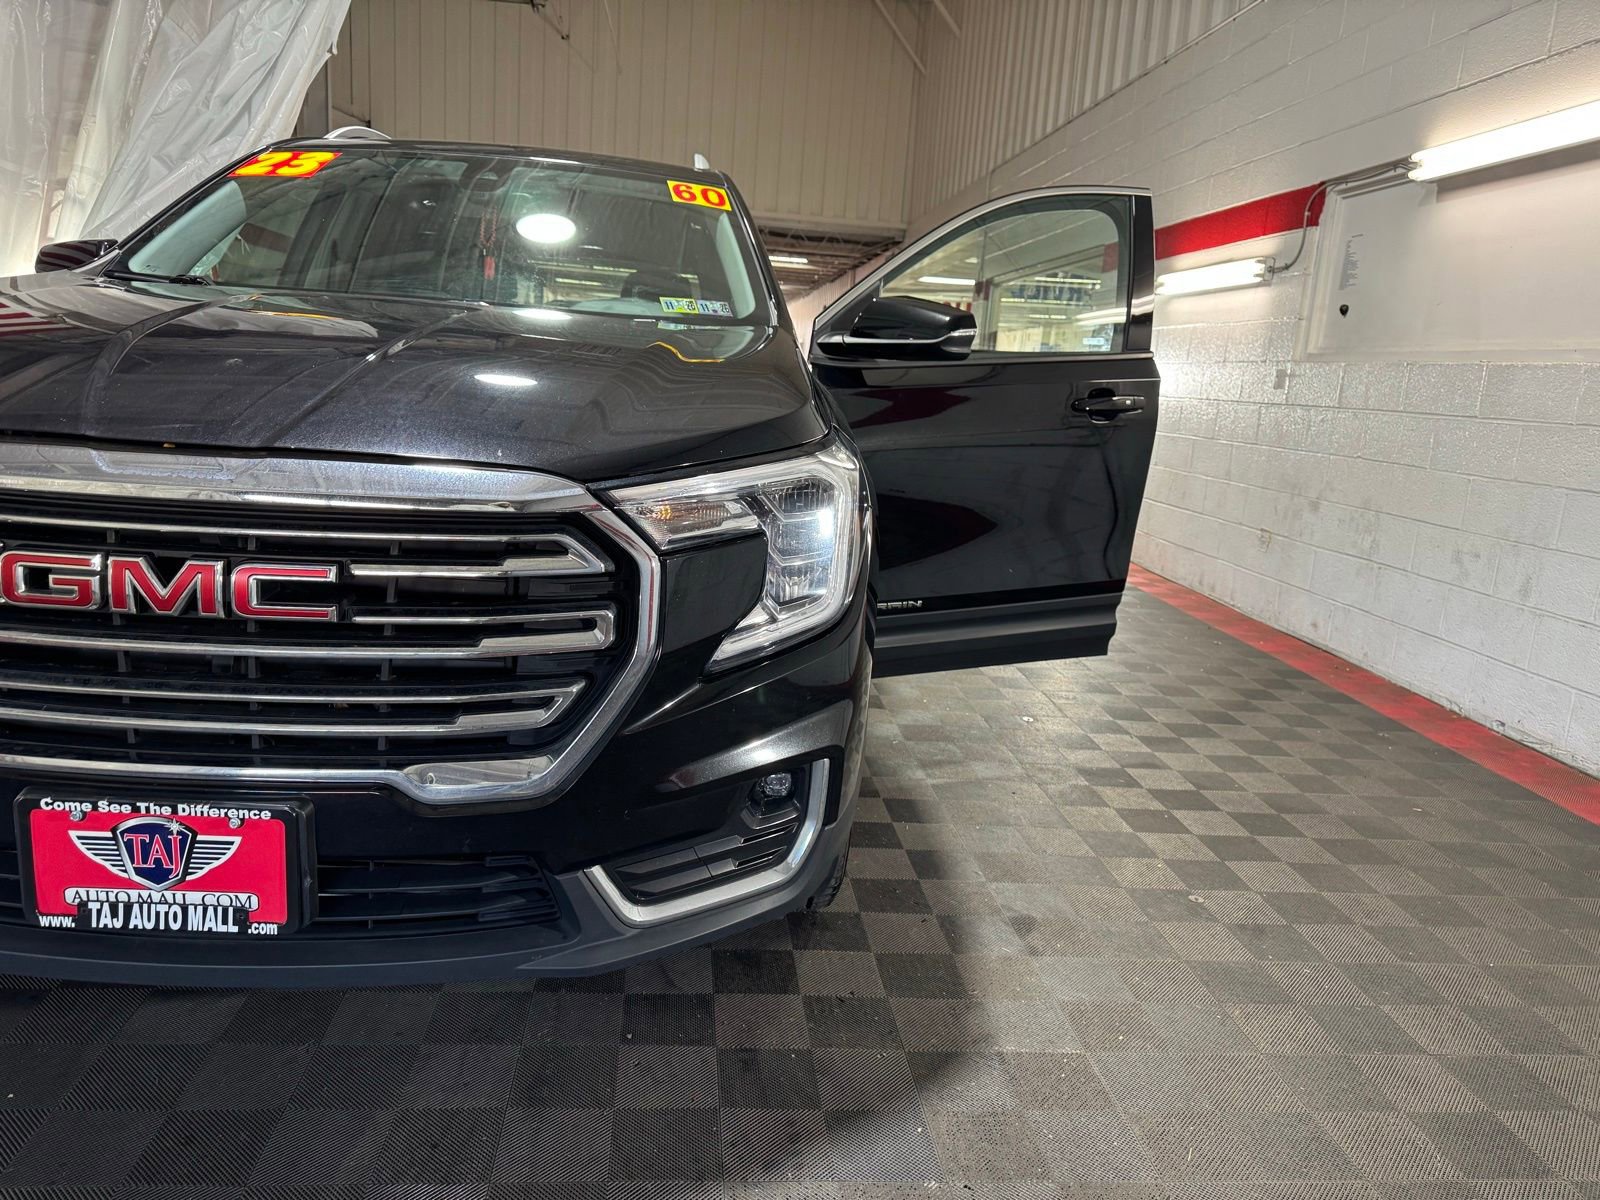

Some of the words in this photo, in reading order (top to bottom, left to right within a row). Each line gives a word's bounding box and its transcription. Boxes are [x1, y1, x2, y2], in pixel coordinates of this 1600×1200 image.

[234, 151, 335, 176] 23
[672, 184, 726, 207] 60
[0, 550, 338, 623] GMC
[40, 797, 93, 812] Come
[97, 799, 132, 814] See
[136, 802, 173, 815] The
[177, 803, 272, 820] Difference
[124, 833, 182, 878] TAJ
[39, 915, 76, 928] www.
[88, 901, 124, 929] TAJ
[129, 902, 183, 930] AUTO
[187, 904, 239, 932] MALL
[247, 922, 279, 935] .com
